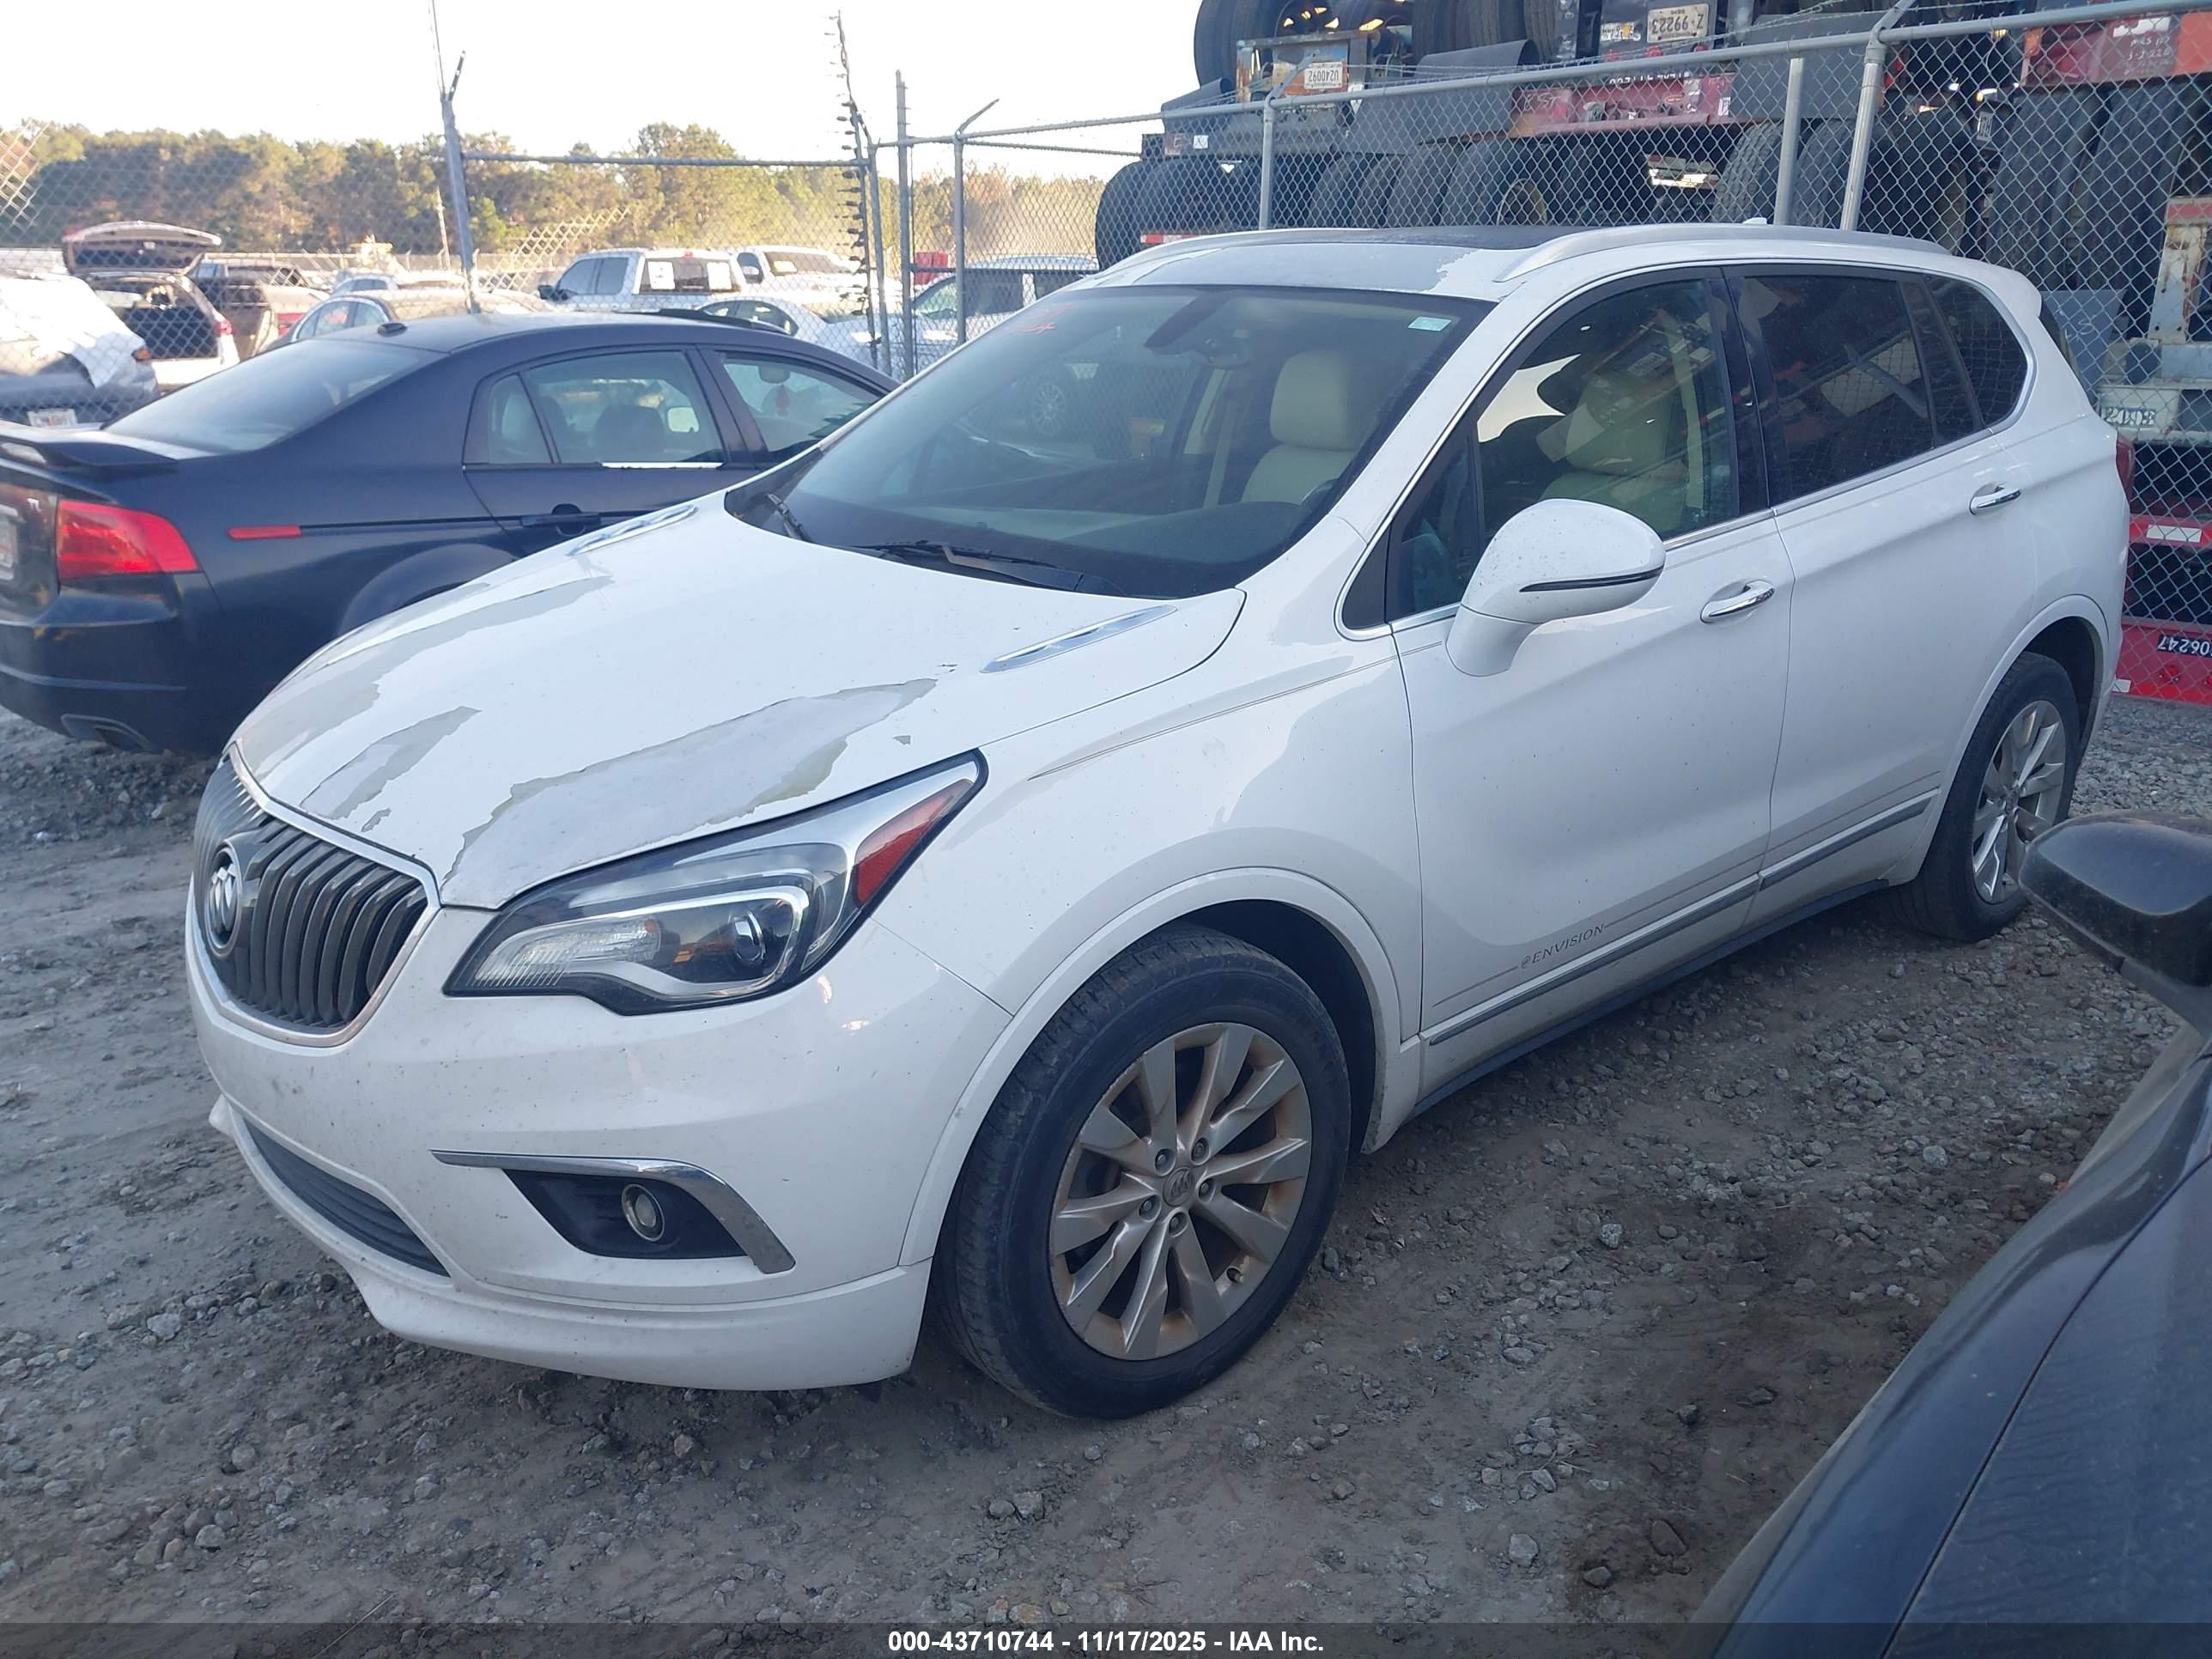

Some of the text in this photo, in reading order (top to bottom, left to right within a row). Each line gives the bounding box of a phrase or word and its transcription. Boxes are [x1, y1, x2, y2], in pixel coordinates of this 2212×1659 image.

[1308, 70, 1340, 84] U240092
[2157, 635, 2212, 657] 06247
[1531, 923, 1605, 963] ENVISION
